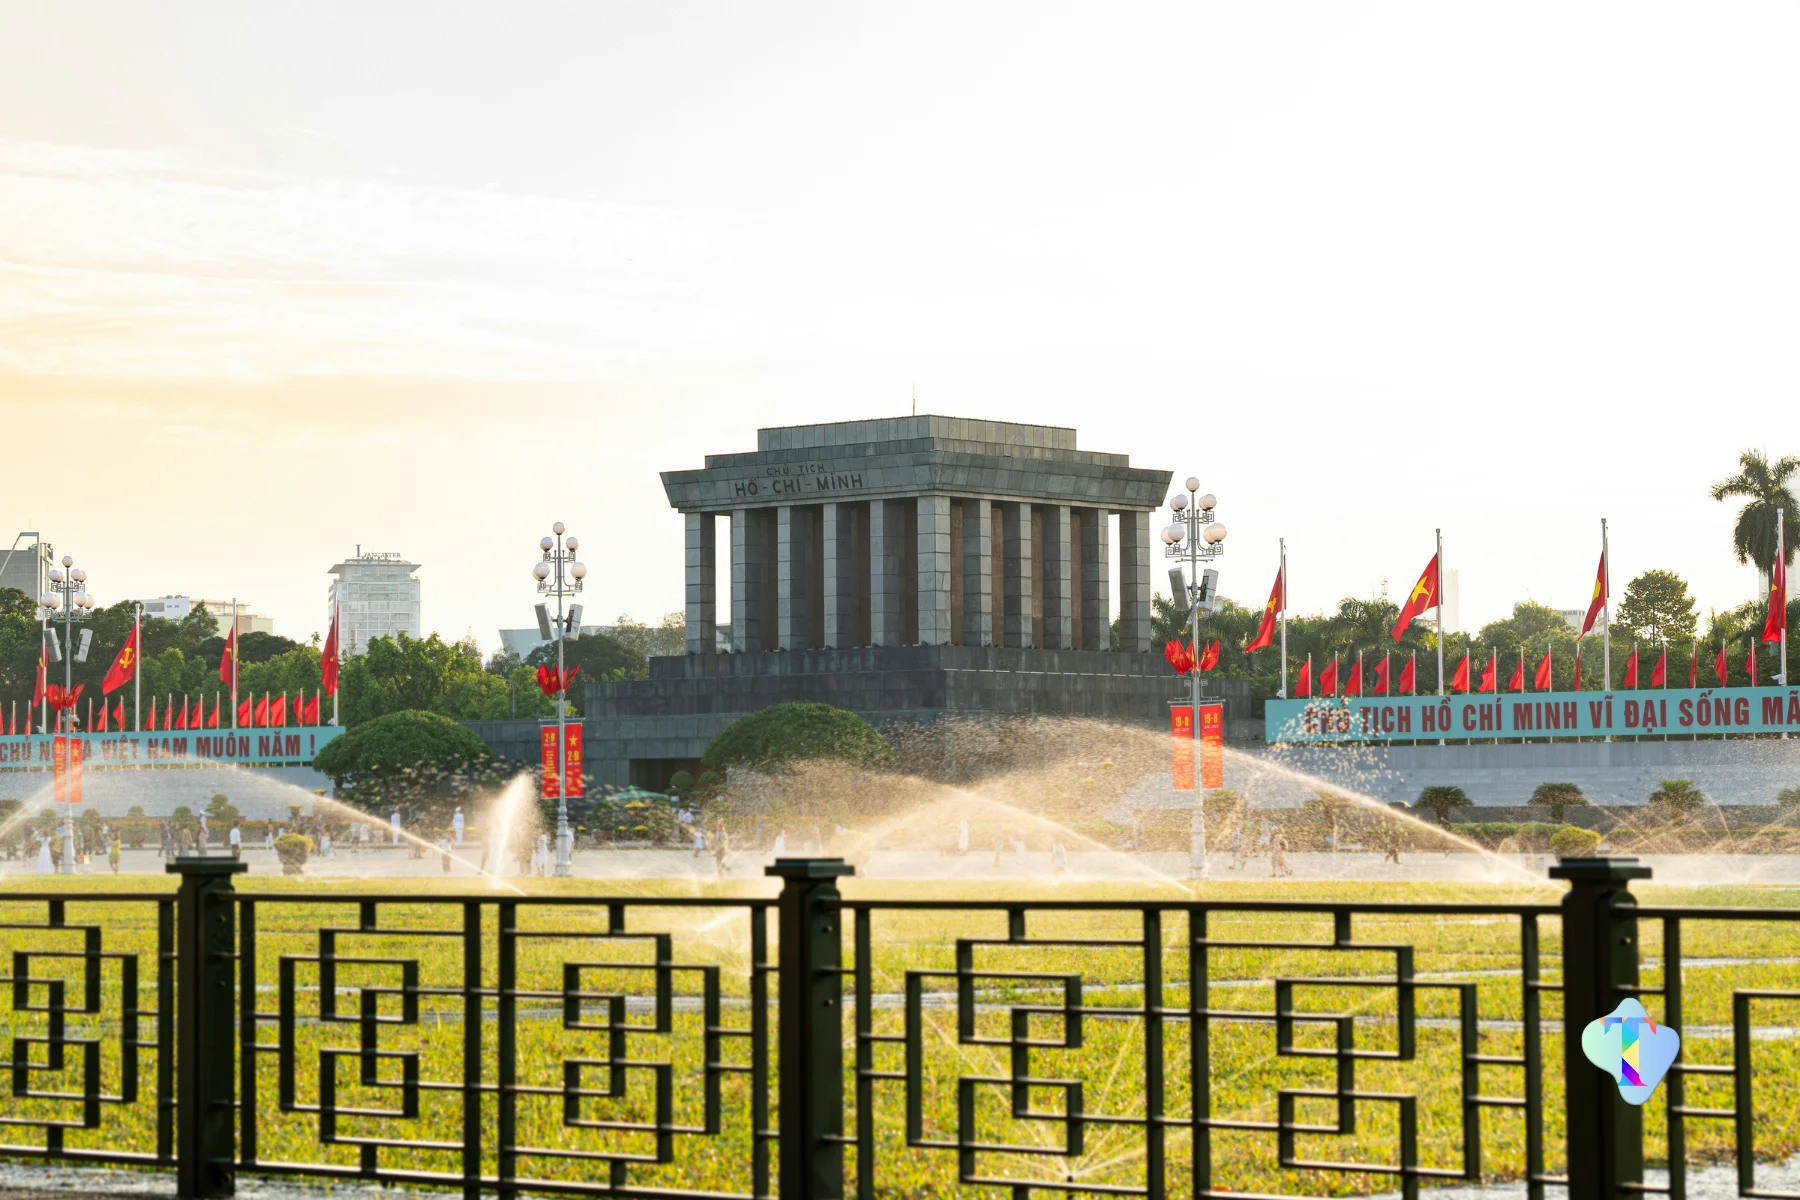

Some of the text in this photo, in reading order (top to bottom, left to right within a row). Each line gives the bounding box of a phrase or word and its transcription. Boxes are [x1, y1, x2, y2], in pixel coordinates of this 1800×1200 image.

[1361, 705, 1411, 738] TỊCH
[1422, 697, 1451, 732] HỒ
[1463, 698, 1503, 731] CHÍ
[1513, 702, 1578, 730] MINH
[1589, 695, 1613, 729] VĨ
[1624, 699, 1667, 733] ĐẠI
[1679, 690, 1749, 727] SỐNG
[148, 737, 187, 759] NAM
[196, 732, 250, 757] MUÔN
[258, 730, 300, 757] NĂM
